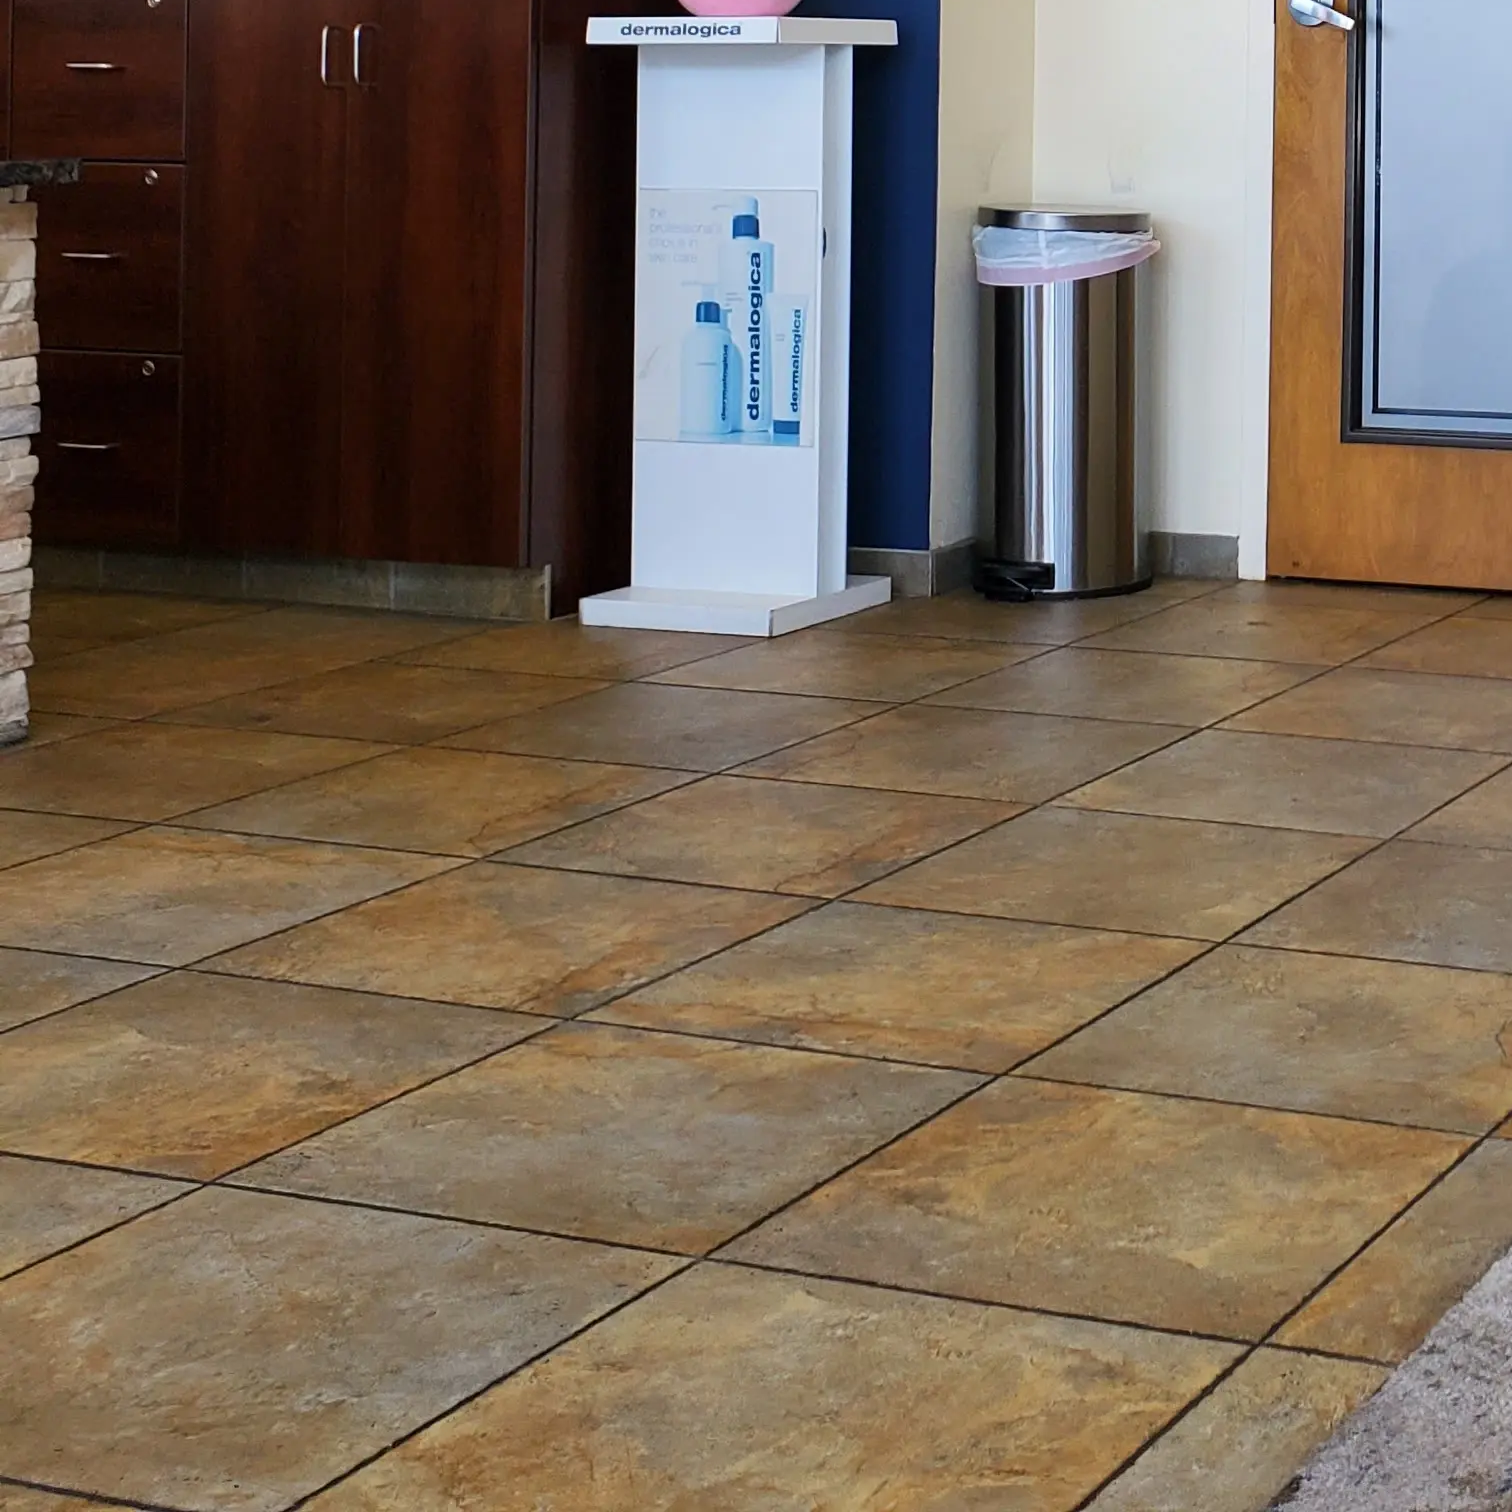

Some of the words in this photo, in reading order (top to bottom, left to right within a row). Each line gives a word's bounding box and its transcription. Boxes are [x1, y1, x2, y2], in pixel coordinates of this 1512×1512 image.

[620, 23, 741, 38] dermalogica
[747, 252, 763, 421] dermalogica
[790, 309, 802, 413] dermalogica
